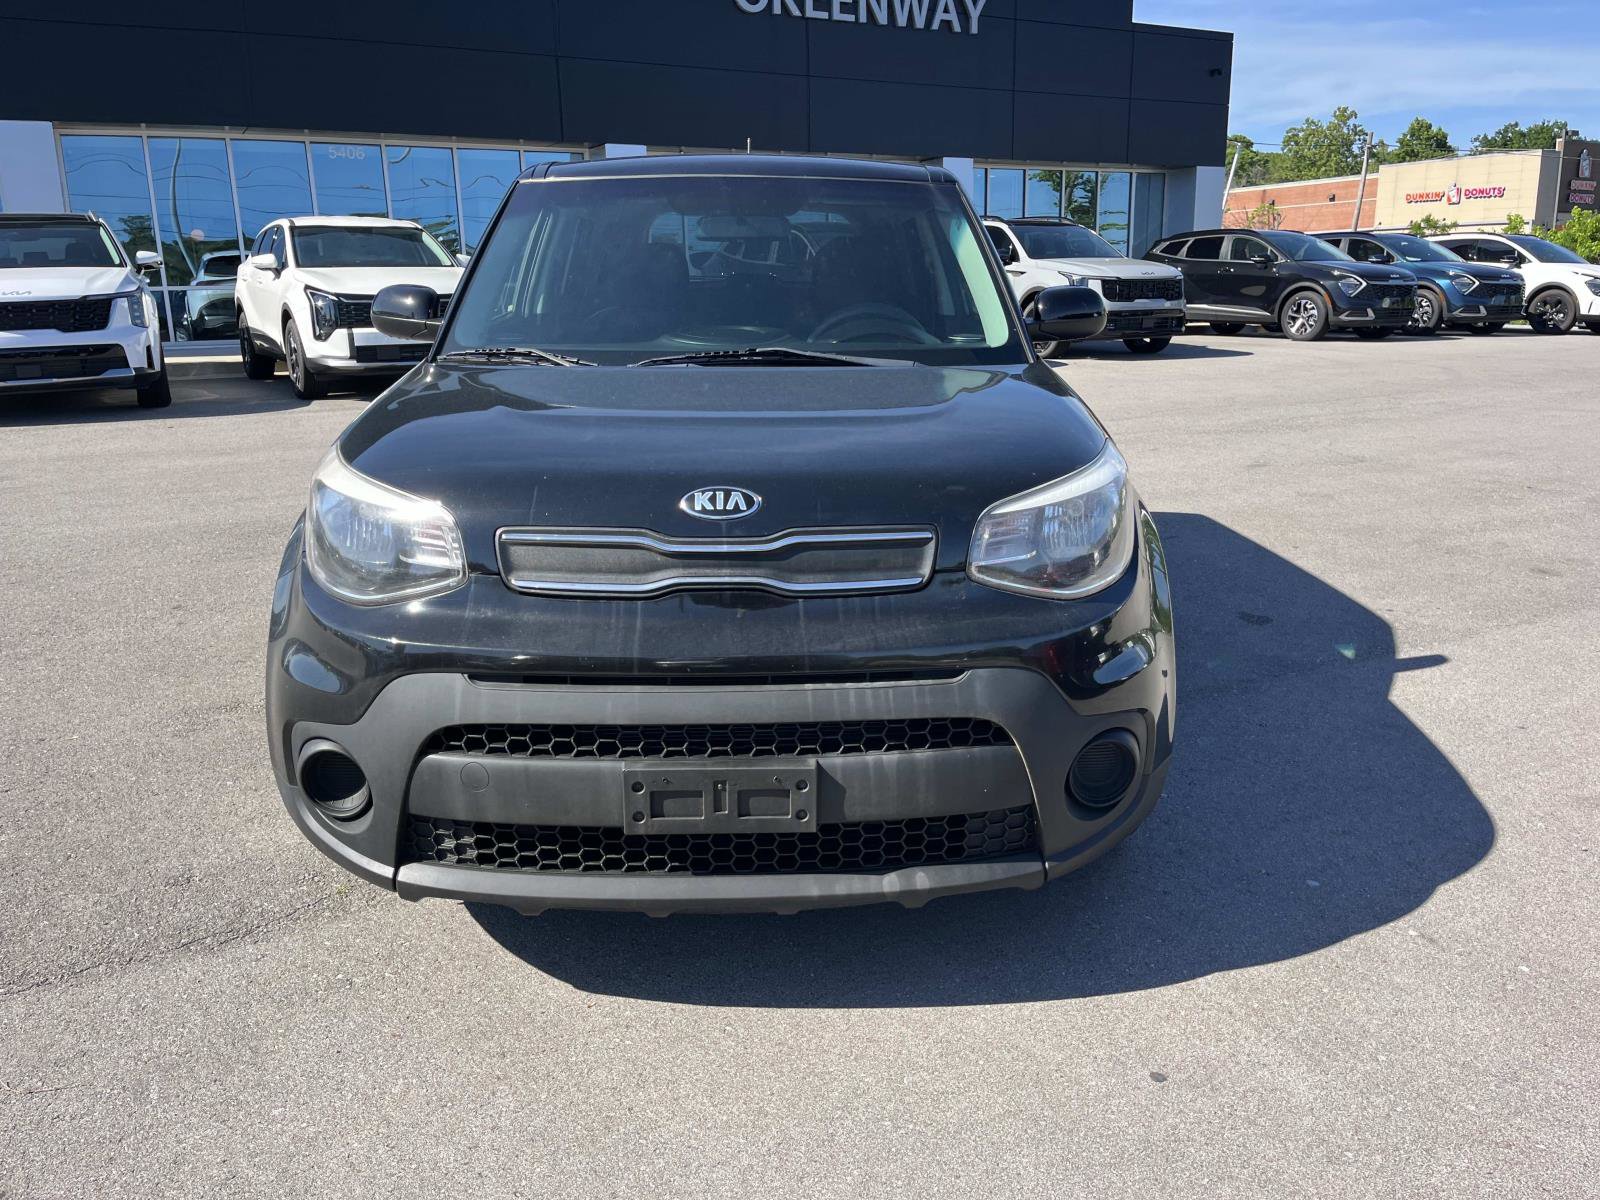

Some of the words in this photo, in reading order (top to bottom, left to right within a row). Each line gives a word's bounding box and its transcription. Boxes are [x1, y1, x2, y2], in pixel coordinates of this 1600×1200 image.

[328, 145, 366, 160] 5406
[1405, 190, 1445, 203] DUNKIN'
[1464, 186, 1505, 199] DONUTS
[694, 491, 747, 511] KIA
